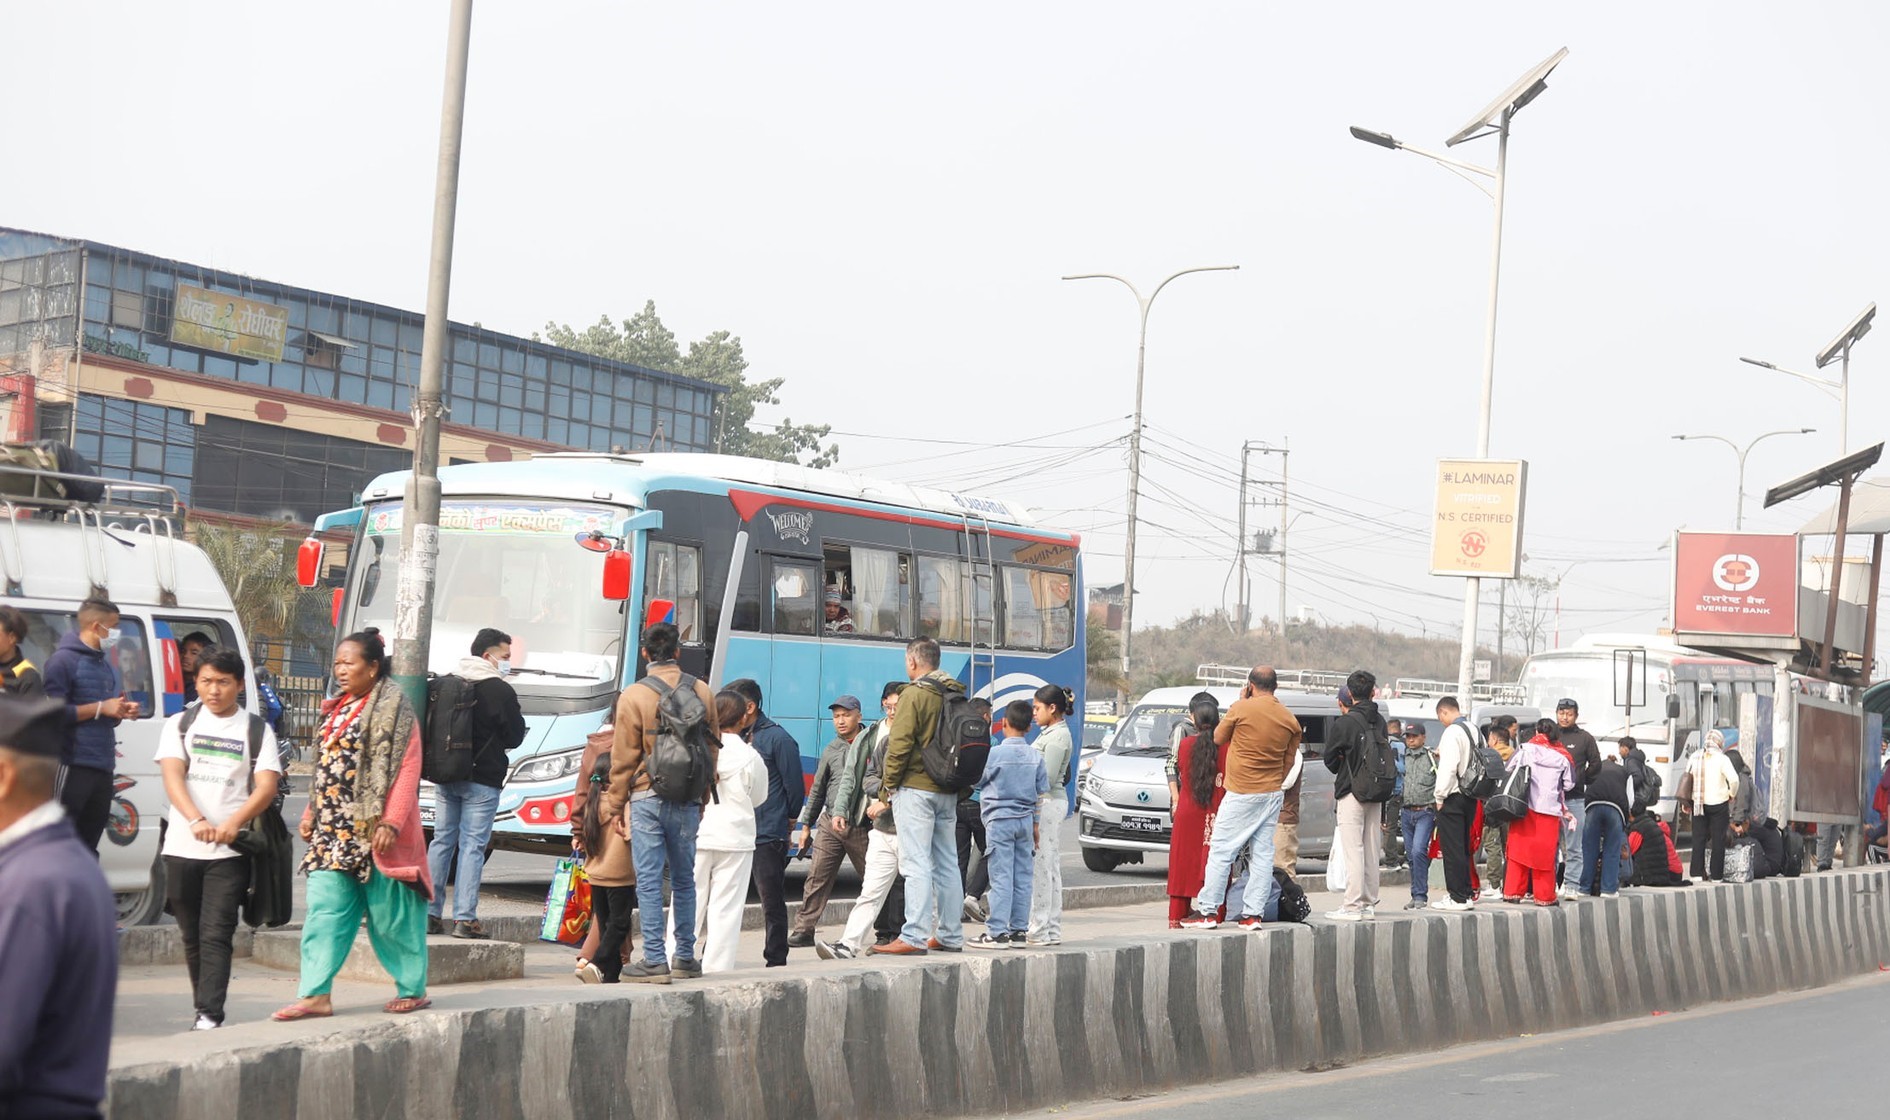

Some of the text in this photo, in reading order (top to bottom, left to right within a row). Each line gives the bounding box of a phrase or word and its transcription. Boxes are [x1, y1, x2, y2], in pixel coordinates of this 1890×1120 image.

[1443, 472, 1515, 485] #LAMINAR
[1460, 513, 1514, 524] CERTIFIED
[1696, 604, 1771, 615] EVEREST BANK
